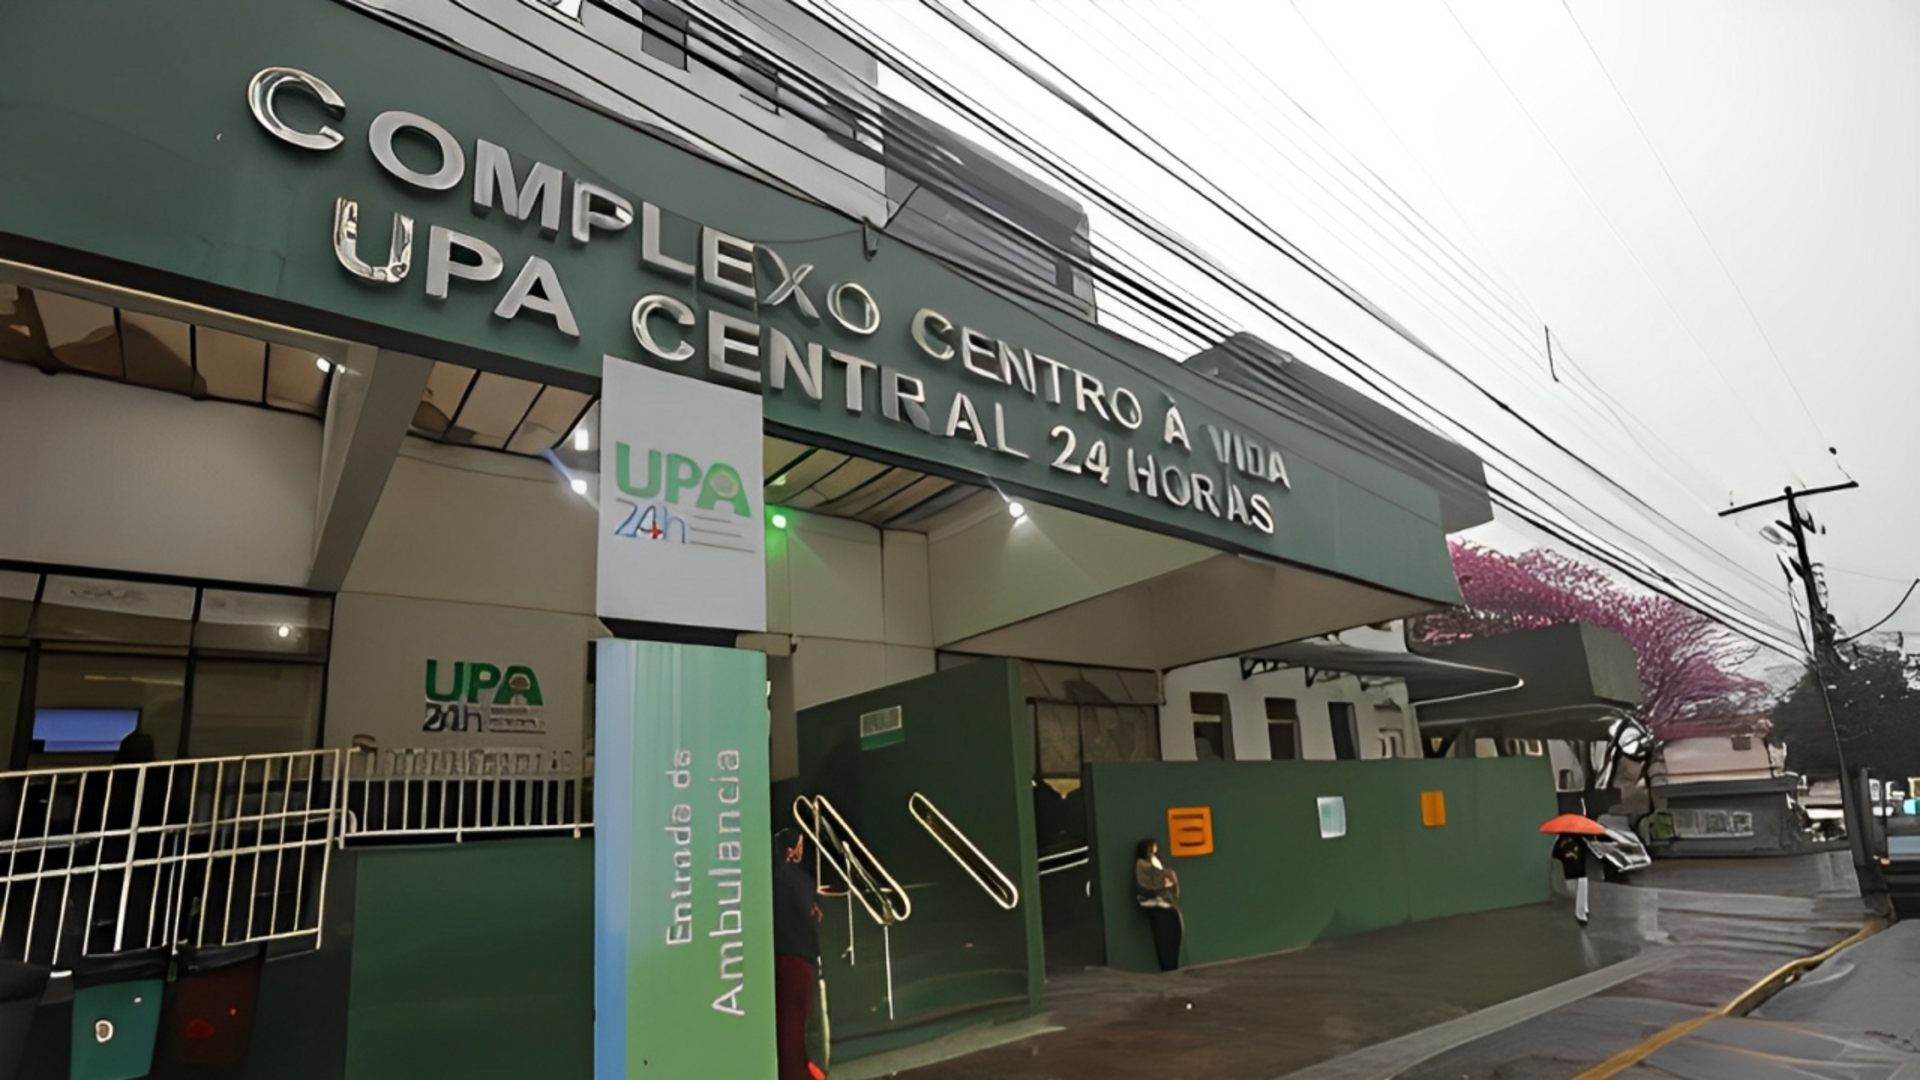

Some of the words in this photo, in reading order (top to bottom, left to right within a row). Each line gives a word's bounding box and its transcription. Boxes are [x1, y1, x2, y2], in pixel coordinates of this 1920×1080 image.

[247, 66, 880, 334] COMPLEXO
[912, 308, 1143, 429] CENTRO
[1208, 424, 1291, 489] VIDA
[333, 197, 579, 338] UPA
[631, 294, 1029, 459] CENTRAL
[1051, 426, 1110, 485] 24
[1127, 448, 1275, 535] HORAS
[616, 441, 752, 518] UPA
[425, 659, 543, 706] UPA
